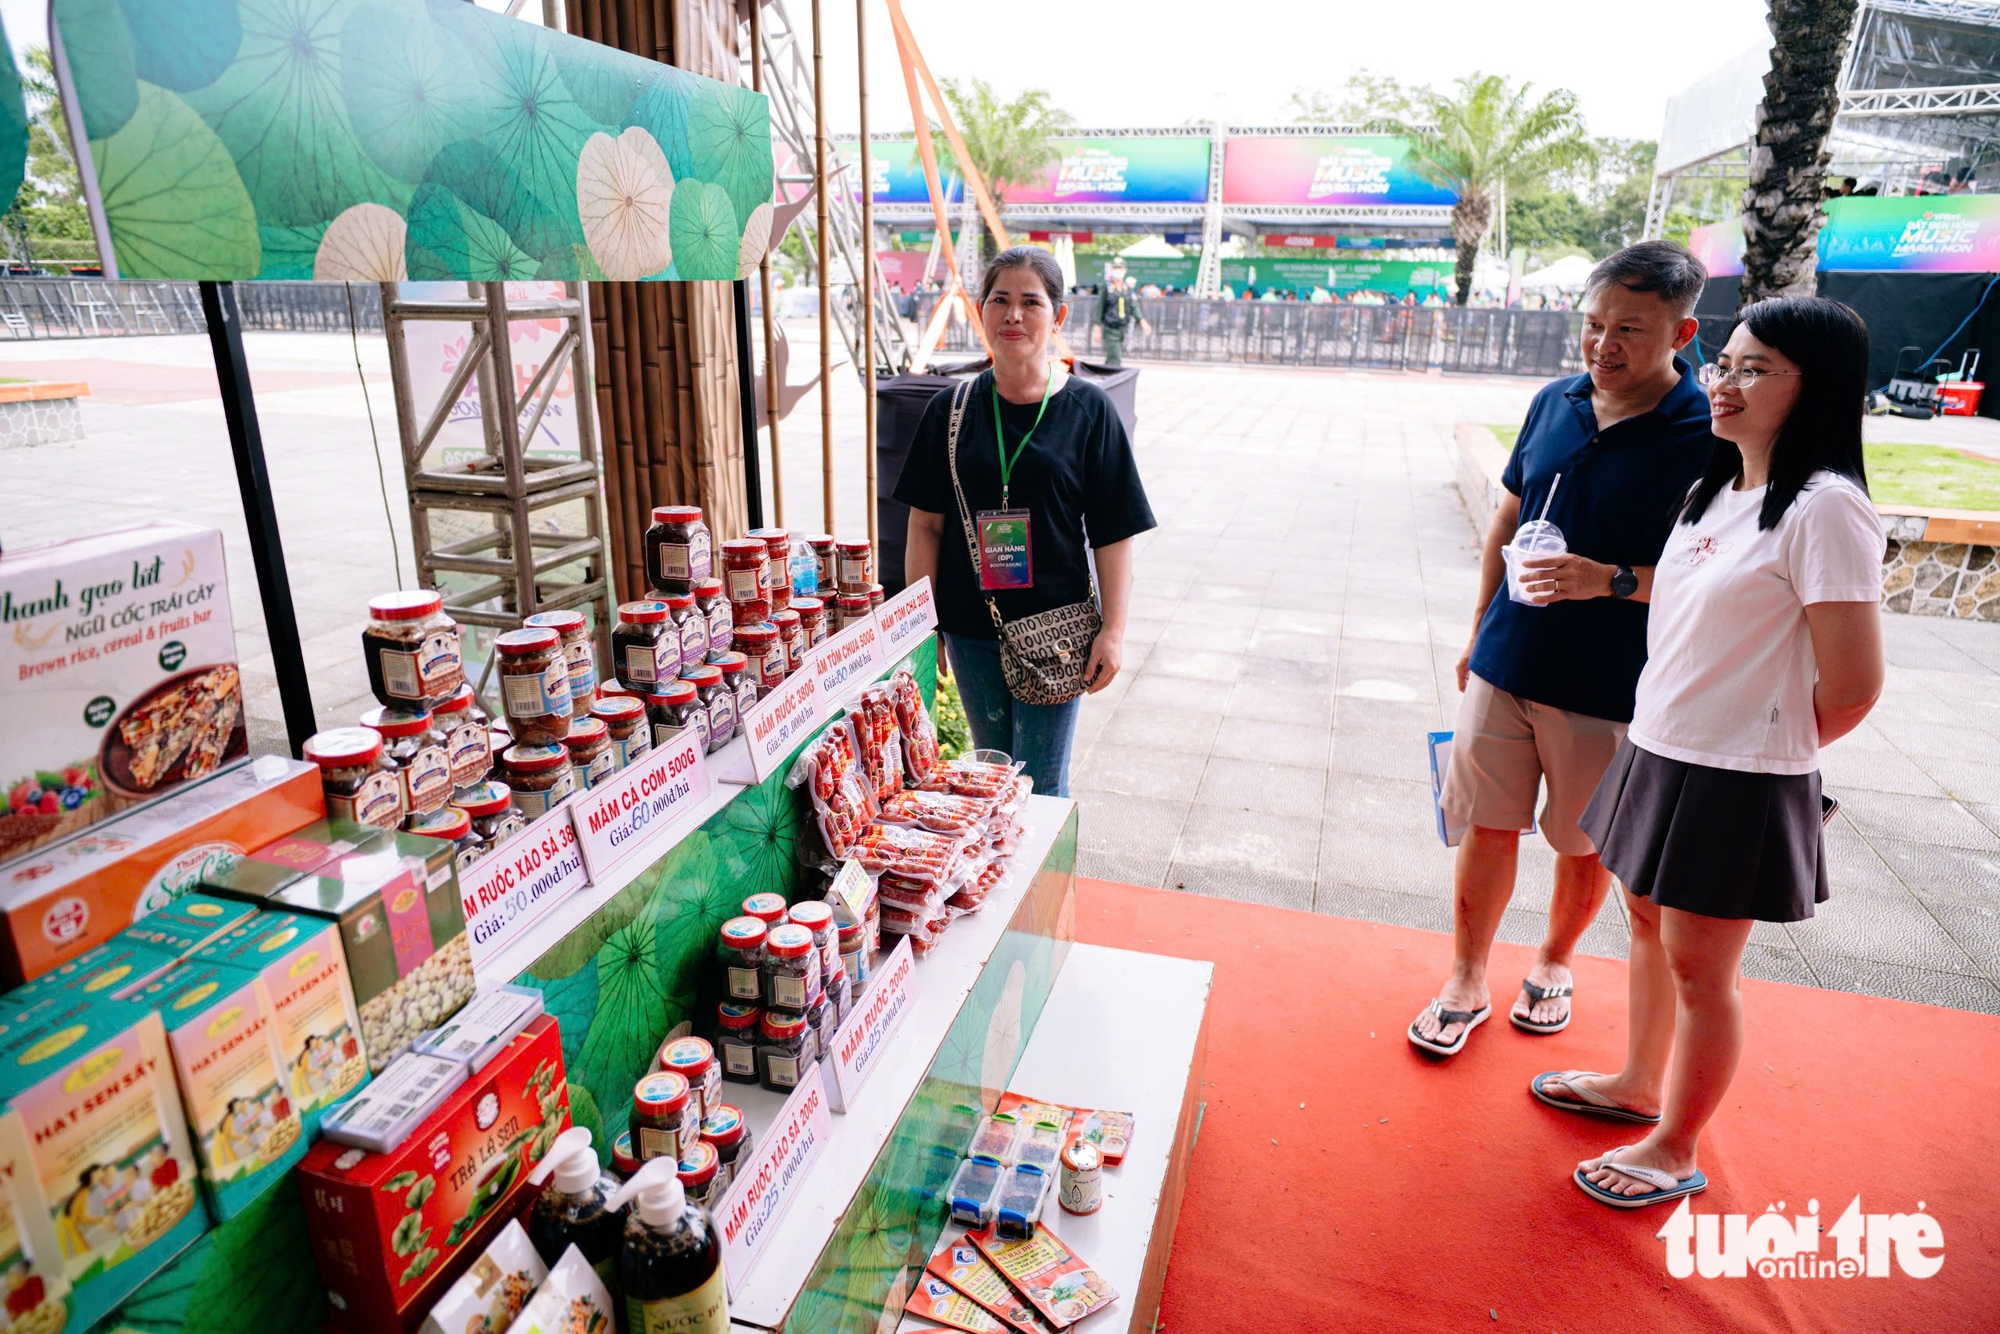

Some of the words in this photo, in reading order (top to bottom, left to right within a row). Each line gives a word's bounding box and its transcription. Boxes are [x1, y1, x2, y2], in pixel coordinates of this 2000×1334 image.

[1059, 166, 1128, 181] MUSIC
[1315, 166, 1391, 181] MUSIC
[1899, 229, 1977, 243] MUSIC
[985, 546, 1003, 554] GIAN
[65, 615, 105, 643] NGŨ
[111, 602, 145, 629] CỐC
[150, 591, 182, 617] TRÁI
[79, 579, 125, 617] gạo
[18, 655, 67, 682] Brown
[70, 645, 100, 666] rice,
[103, 628, 143, 655] cereal
[147, 627, 155, 641] &
[159, 616, 190, 639] fruits
[193, 609, 212, 624] bar
[827, 648, 842, 669] TÔM
[842, 638, 860, 660] CHUA
[859, 628, 875, 648] 500G
[775, 689, 797, 726] RUỐC
[797, 676, 815, 704] 380G
[588, 798, 621, 835] MẮM
[621, 782, 640, 811] CÁ
[641, 764, 668, 797] CƠM
[669, 747, 696, 778] 500G
[477, 863, 516, 908] RUỐC
[516, 847, 542, 881] XÀO
[541, 829, 560, 861] SẢ
[299, 978, 319, 994] SEN
[841, 1029, 865, 1068] MẮM
[864, 989, 889, 1029] RUỐC
[889, 957, 910, 996] 200G
[221, 1034, 244, 1055] SEN
[83, 1082, 120, 1113] SEN
[449, 1154, 477, 1192] TRÀ
[479, 1134, 497, 1166] LÁ
[724, 1198, 748, 1246] MẮM
[748, 1161, 773, 1205] RUỐC
[771, 1140, 790, 1175] XÀO
[788, 1116, 801, 1146] SẢ
[800, 1089, 819, 1126] 200G
